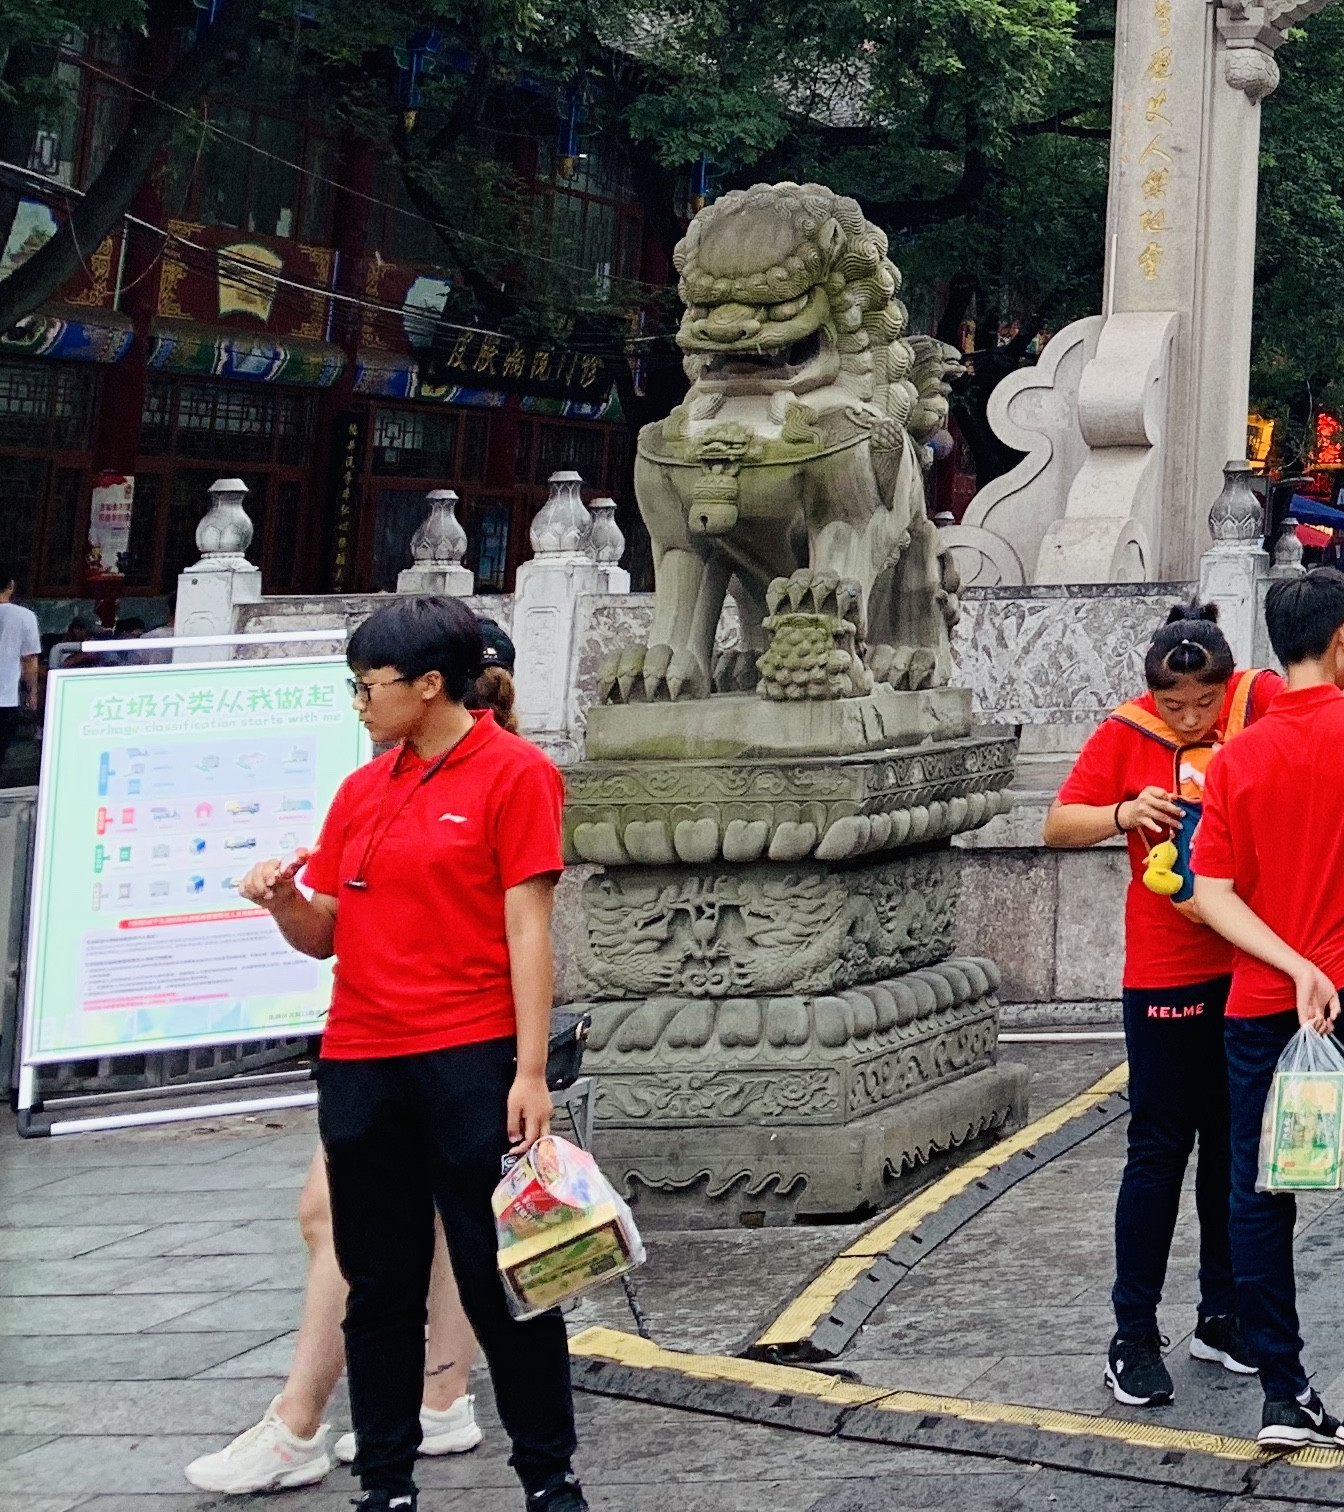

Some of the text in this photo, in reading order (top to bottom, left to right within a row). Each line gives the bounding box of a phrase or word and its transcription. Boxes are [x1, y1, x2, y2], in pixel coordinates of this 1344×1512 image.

[93, 684, 335, 720] 垃圾分类从我做起
[145, 719, 237, 733] classification
[241, 714, 284, 726] starts
[288, 712, 318, 723] with
[323, 712, 342, 721] me
[1147, 1002, 1205, 1018] KELME
